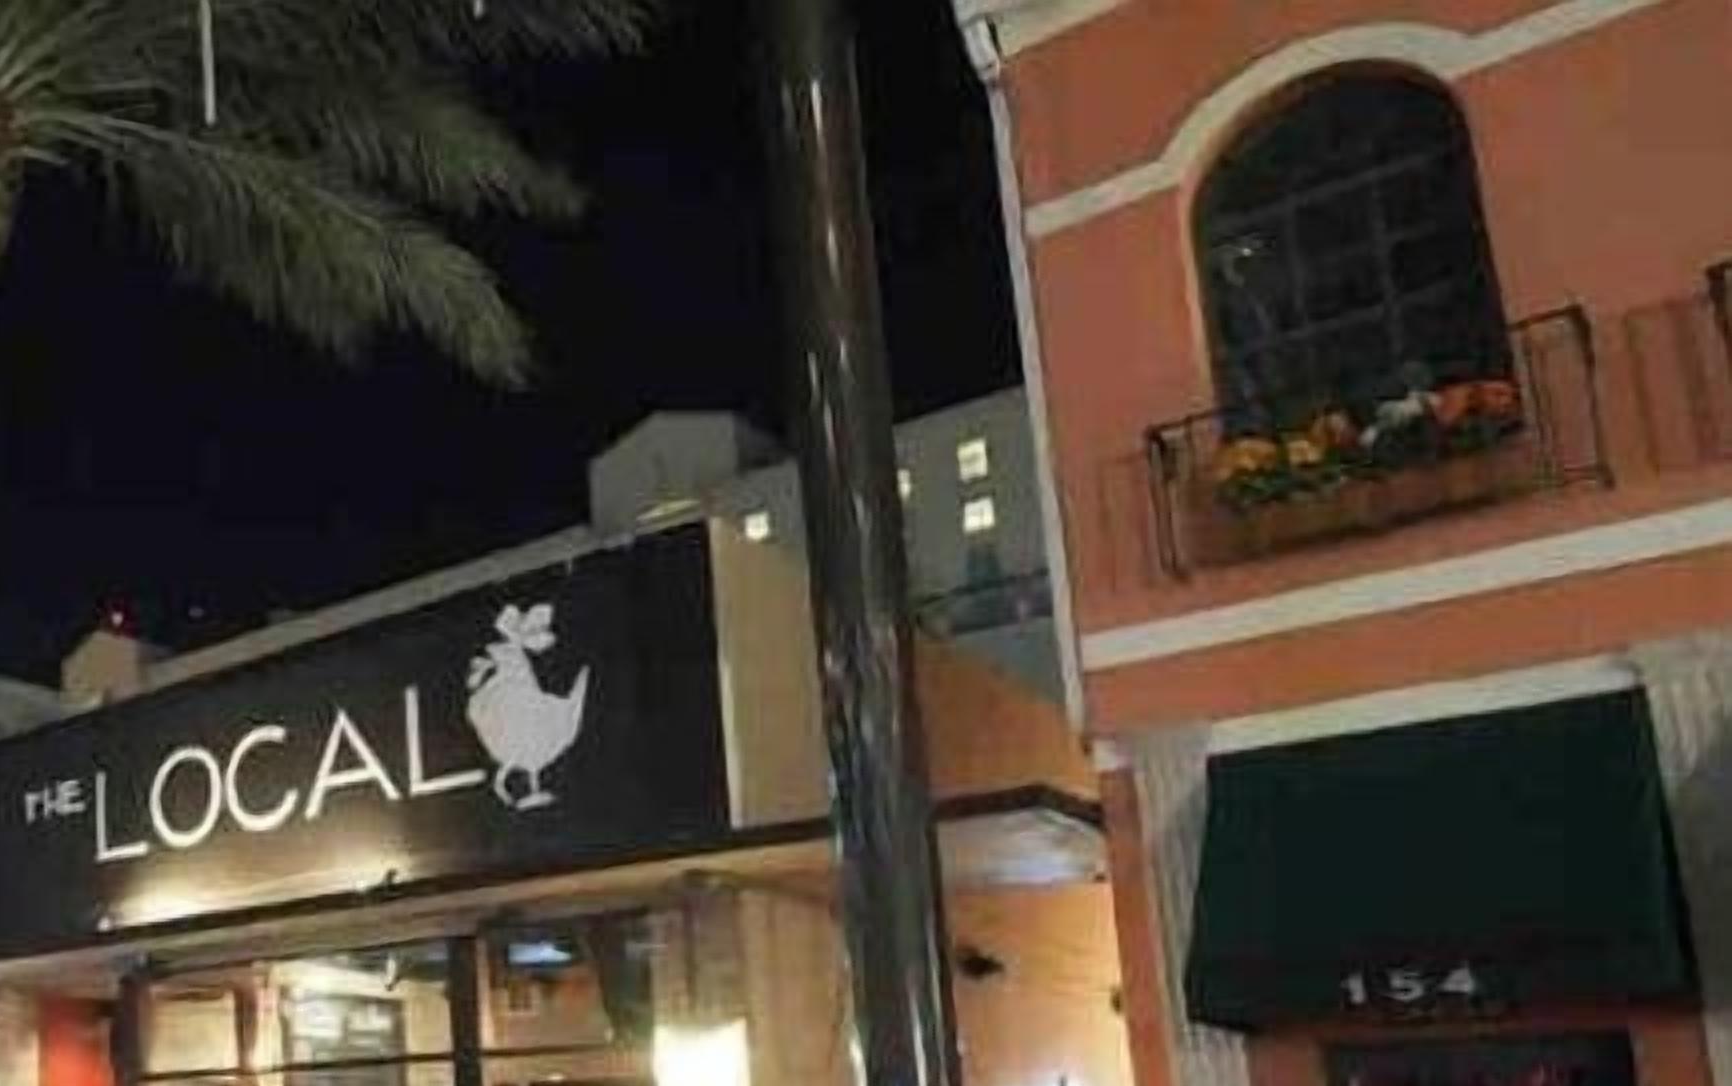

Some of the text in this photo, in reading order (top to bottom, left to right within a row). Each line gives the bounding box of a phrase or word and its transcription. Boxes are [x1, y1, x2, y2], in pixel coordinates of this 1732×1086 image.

[24, 686, 486, 863] THE LOCAL
[1341, 962, 1476, 1004] 154
